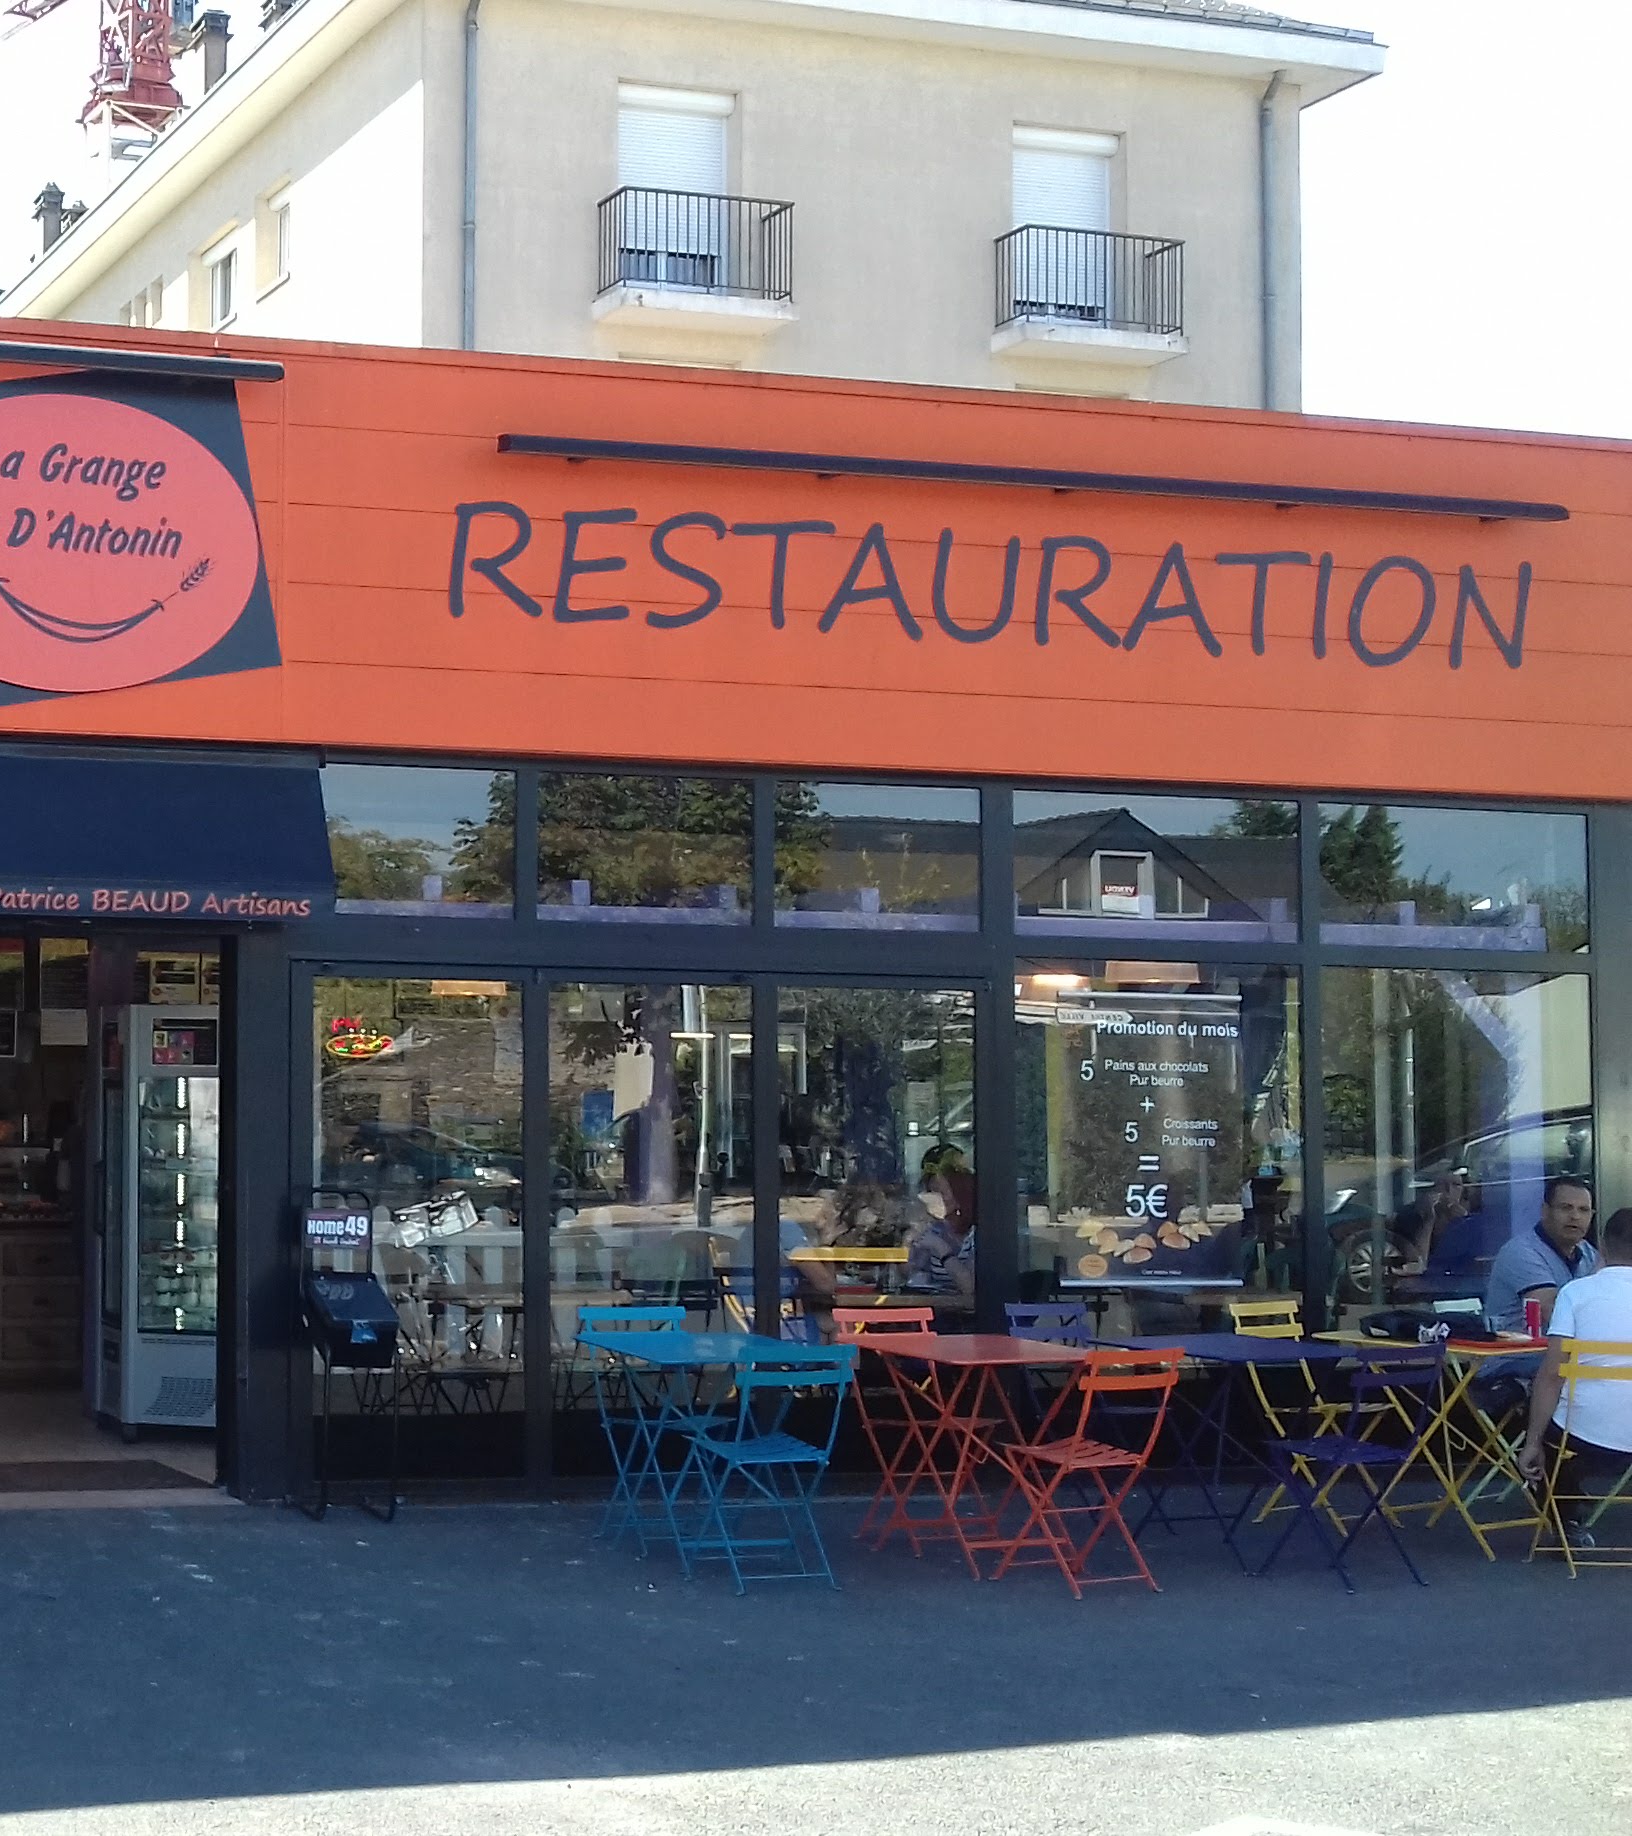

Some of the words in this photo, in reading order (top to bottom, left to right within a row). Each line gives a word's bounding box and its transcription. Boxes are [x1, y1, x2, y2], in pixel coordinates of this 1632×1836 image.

[39, 442, 167, 502] Grange
[6, 506, 183, 560] D'Antonin
[447, 500, 1532, 670] RESTAURATION
[92, 889, 191, 913] BEAUD
[200, 892, 311, 917] Artisans
[1096, 1020, 1174, 1035] Promotion
[1177, 1022, 1198, 1037] du
[1202, 1023, 1239, 1038] mois
[1080, 1060, 1095, 1081] 5
[1104, 1059, 1135, 1071] Pains
[1137, 1062, 1157, 1071] aux
[1159, 1062, 1209, 1073] chocolats
[1129, 1074, 1149, 1086] Pur
[1151, 1075, 1184, 1087] beurre
[1124, 1122, 1139, 1142] 5
[1163, 1118, 1218, 1131] Croissants
[1161, 1135, 1180, 1146] Pur
[1182, 1136, 1216, 1147] beurre
[1125, 1184, 1168, 1218] 5€
[307, 1216, 368, 1236] Home49
